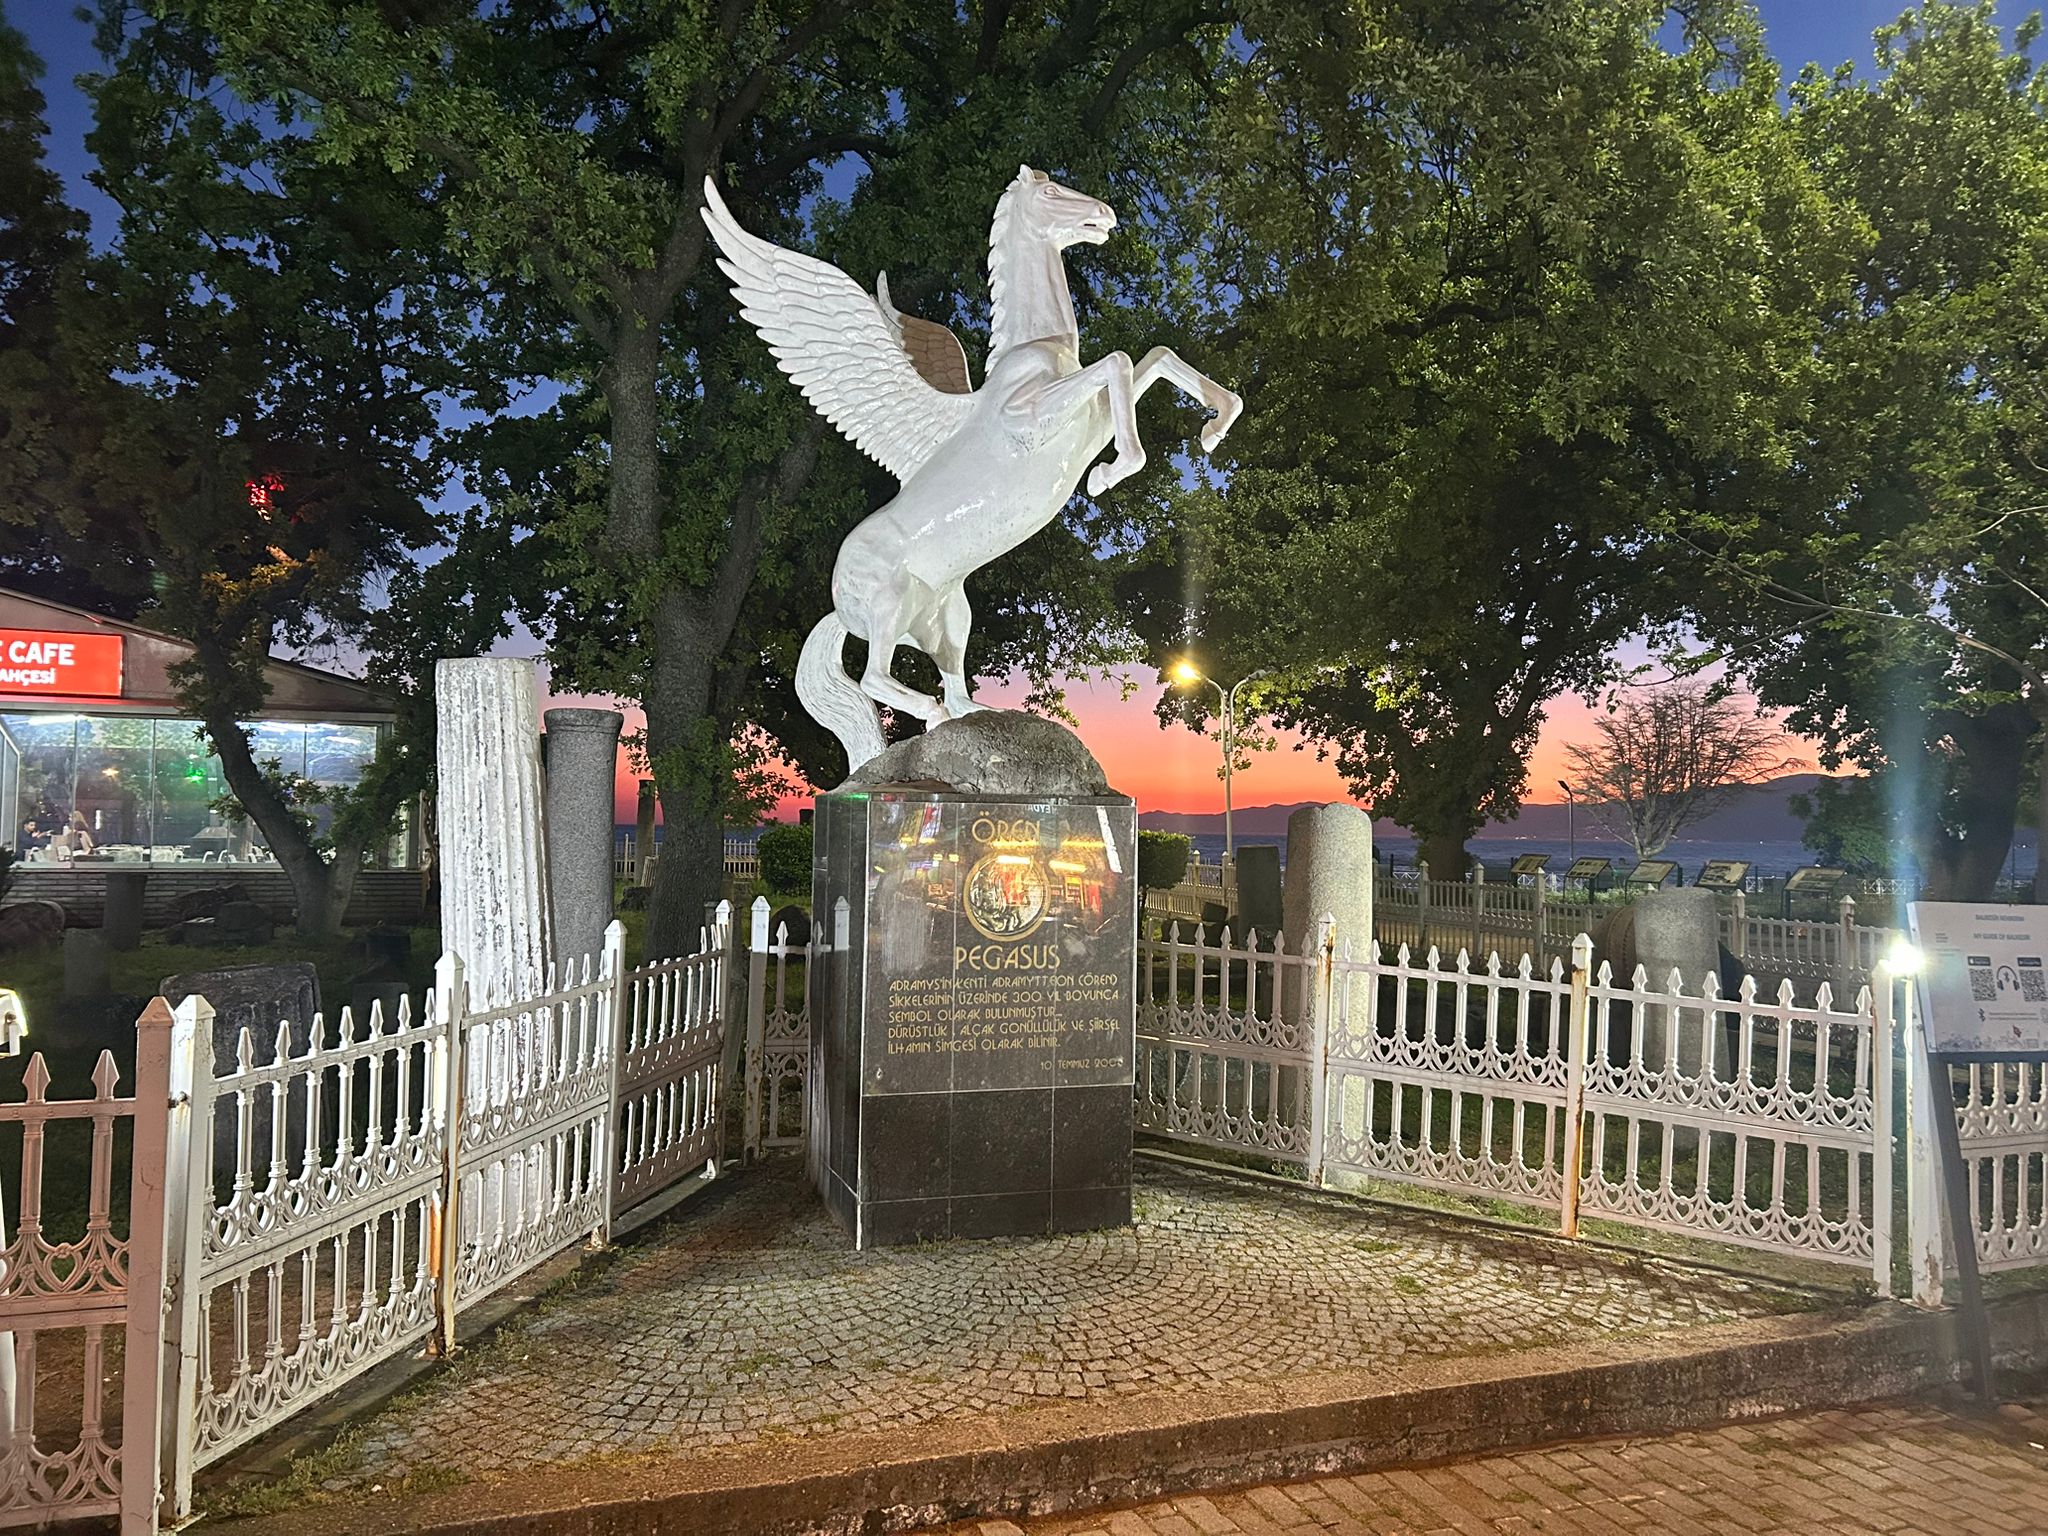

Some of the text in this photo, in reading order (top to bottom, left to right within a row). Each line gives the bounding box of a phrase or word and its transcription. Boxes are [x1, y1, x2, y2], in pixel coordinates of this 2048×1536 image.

[8, 640, 75, 666] CAFE
[972, 811, 1040, 843] ÖREN
[955, 944, 1061, 971] PEGASUS
[955, 974, 987, 989] KENTİ
[1078, 972, 1118, 986] (ÖREN)
[889, 992, 953, 1008] SİKKELERİNİN
[958, 990, 1008, 1005] ÜZERİNDE
[1013, 991, 1042, 1003] 300
[1066, 989, 1119, 1002] BOYUNCA
[889, 1010, 932, 1023] SEMBOL
[937, 1008, 981, 1021] OLARAK
[960, 1023, 995, 1037] ALÇAK
[1071, 1019, 1084, 1031] VE
[888, 1041, 931, 1054] İLHAMIN
[935, 1038, 977, 1053] SİMGESİ
[981, 1037, 1024, 1050] OLARAK
[1040, 1060, 1053, 1071] 10
[1058, 1058, 1090, 1069] TEMMUZ
